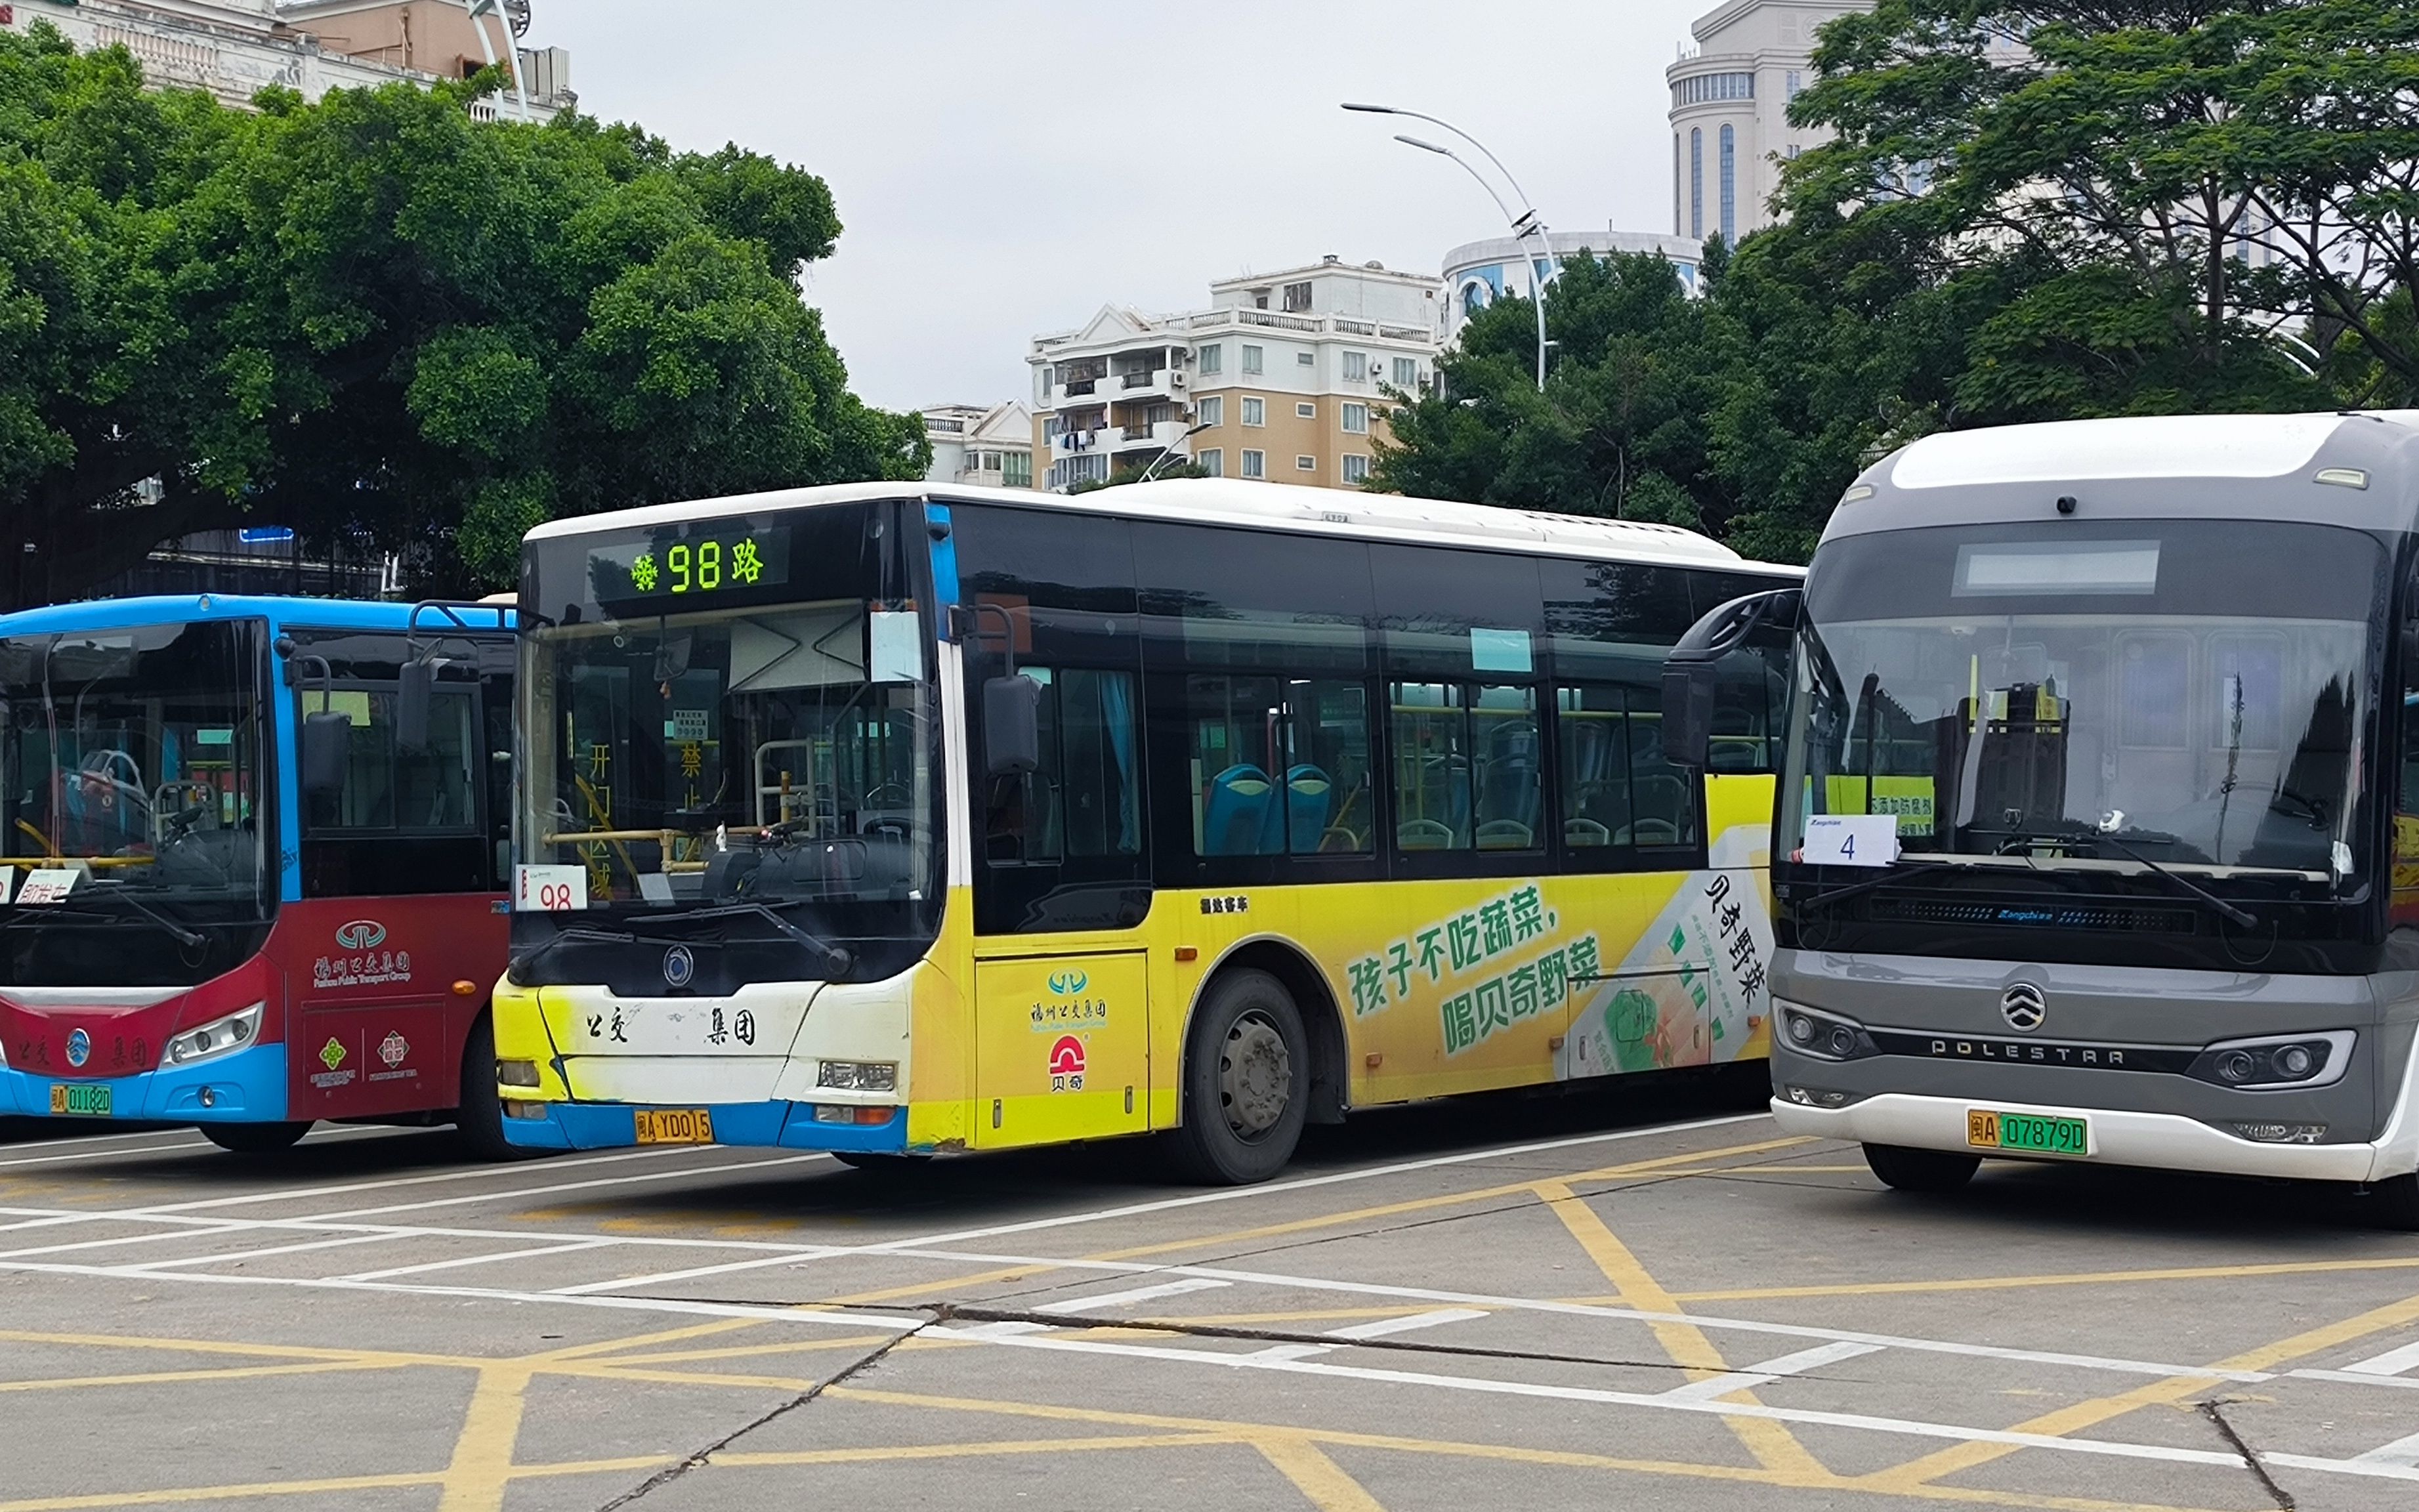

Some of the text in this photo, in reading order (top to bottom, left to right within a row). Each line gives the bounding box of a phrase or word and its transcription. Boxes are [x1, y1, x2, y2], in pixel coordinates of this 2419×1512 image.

[1840, 833, 1855, 860] 4
[541, 883, 572, 910] 98
[1704, 875, 1765, 1009] 贝奇野菜
[1442, 936, 1600, 1054] 喝贝奇野菜
[587, 1006, 755, 1046] 公交 集团
[1931, 1040, 2124, 1064] POLESTAR
[1052, 1075, 1083, 1092] 贝奇
